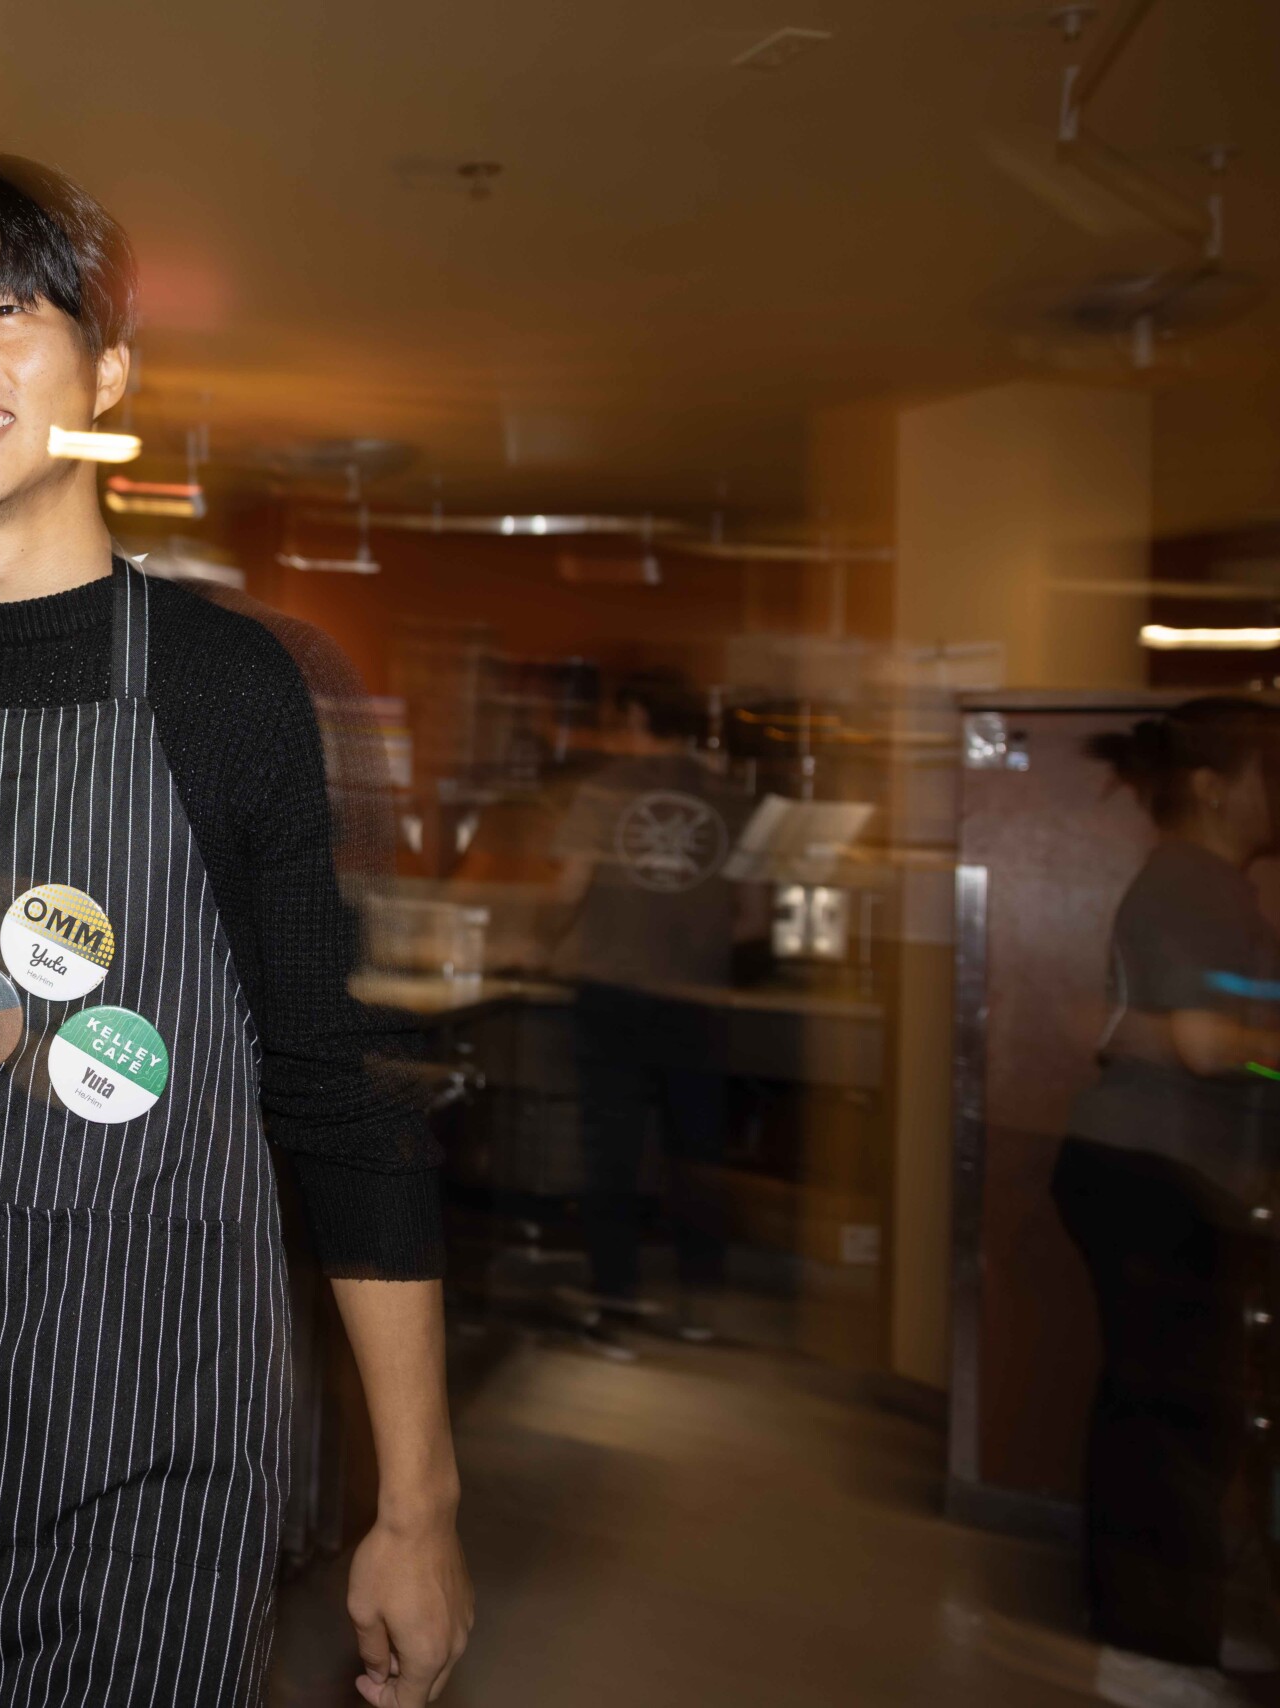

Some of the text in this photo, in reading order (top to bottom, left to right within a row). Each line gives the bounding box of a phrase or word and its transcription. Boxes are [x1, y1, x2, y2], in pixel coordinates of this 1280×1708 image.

[23, 897, 106, 954] OMM
[31, 944, 68, 976] Yuta
[27, 969, 54, 988] He/Him
[86, 1017, 162, 1068] KELLEY
[92, 1038, 142, 1075] CAFÉ
[74, 1088, 103, 1109] He/Him
[81, 1066, 116, 1099] Yuta
